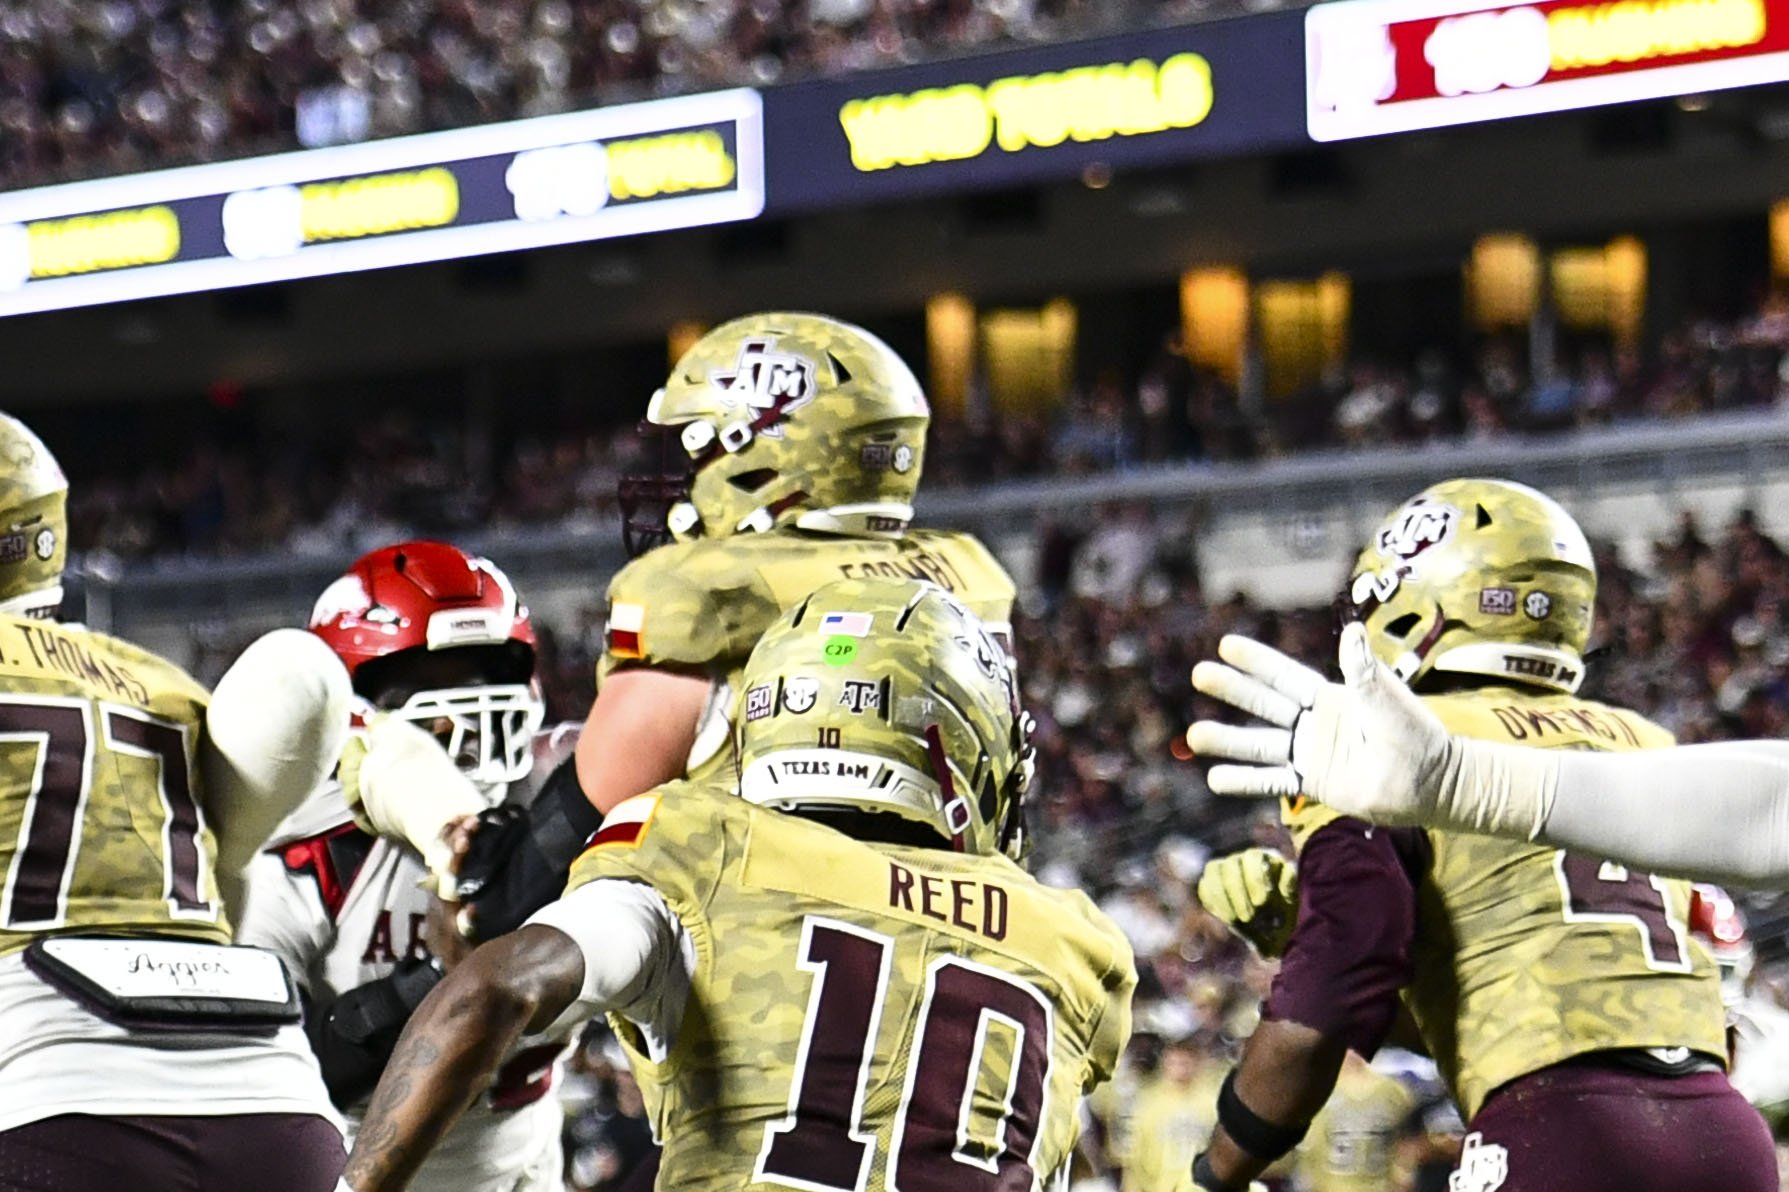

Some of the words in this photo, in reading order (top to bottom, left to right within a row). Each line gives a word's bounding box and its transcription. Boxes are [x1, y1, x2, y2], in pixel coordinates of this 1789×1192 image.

[14, 624, 150, 706] THOMAS
[825, 644, 853, 656] C2P
[782, 760, 830, 775] TEXAS
[817, 726, 841, 749] 10
[0, 692, 218, 929] 77
[888, 862, 1008, 943] REED
[1552, 847, 1693, 974] 4
